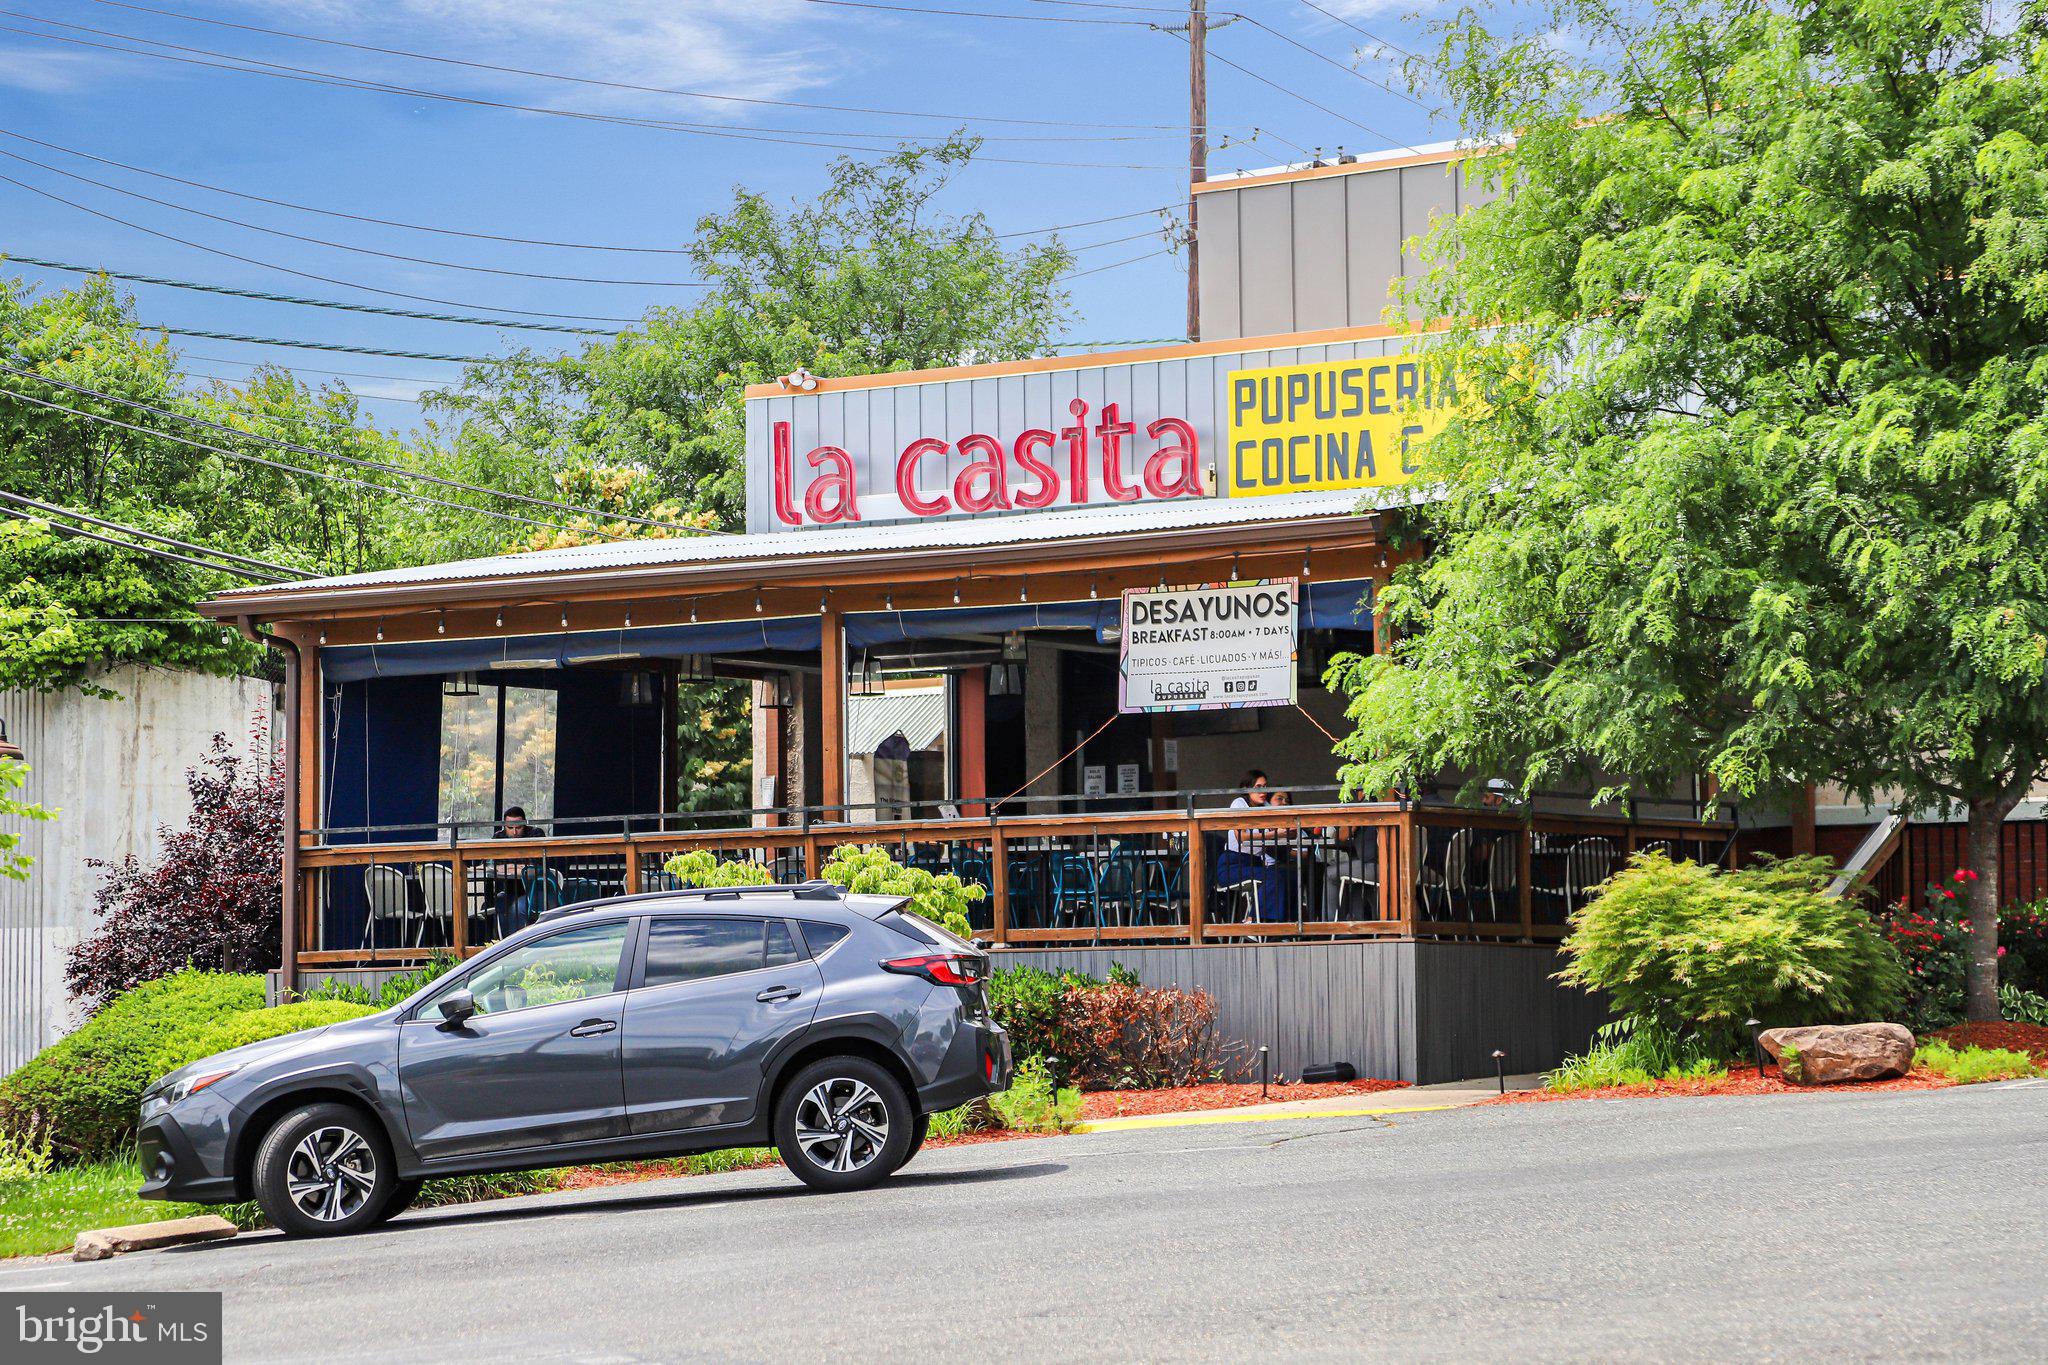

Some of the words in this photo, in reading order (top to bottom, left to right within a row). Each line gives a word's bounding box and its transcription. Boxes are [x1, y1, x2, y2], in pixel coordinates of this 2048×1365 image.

[774, 421, 860, 526] la
[897, 398, 1204, 516] casita
[1235, 429, 1376, 488] COCINA
[1132, 591, 1290, 625] DESAYUNOS
[1132, 628, 1208, 644] BREAKFAST
[1210, 630, 1245, 640] 8:00AM
[1255, 627, 1260, 636] 7
[1264, 625, 1289, 636] DAYS
[1173, 654, 1195, 666] CAFÉ
[1200, 653, 1246, 665] LICUADOS
[1252, 652, 1257, 660] Y
[1150, 679, 1162, 694] la
[1168, 678, 1210, 693] casita
